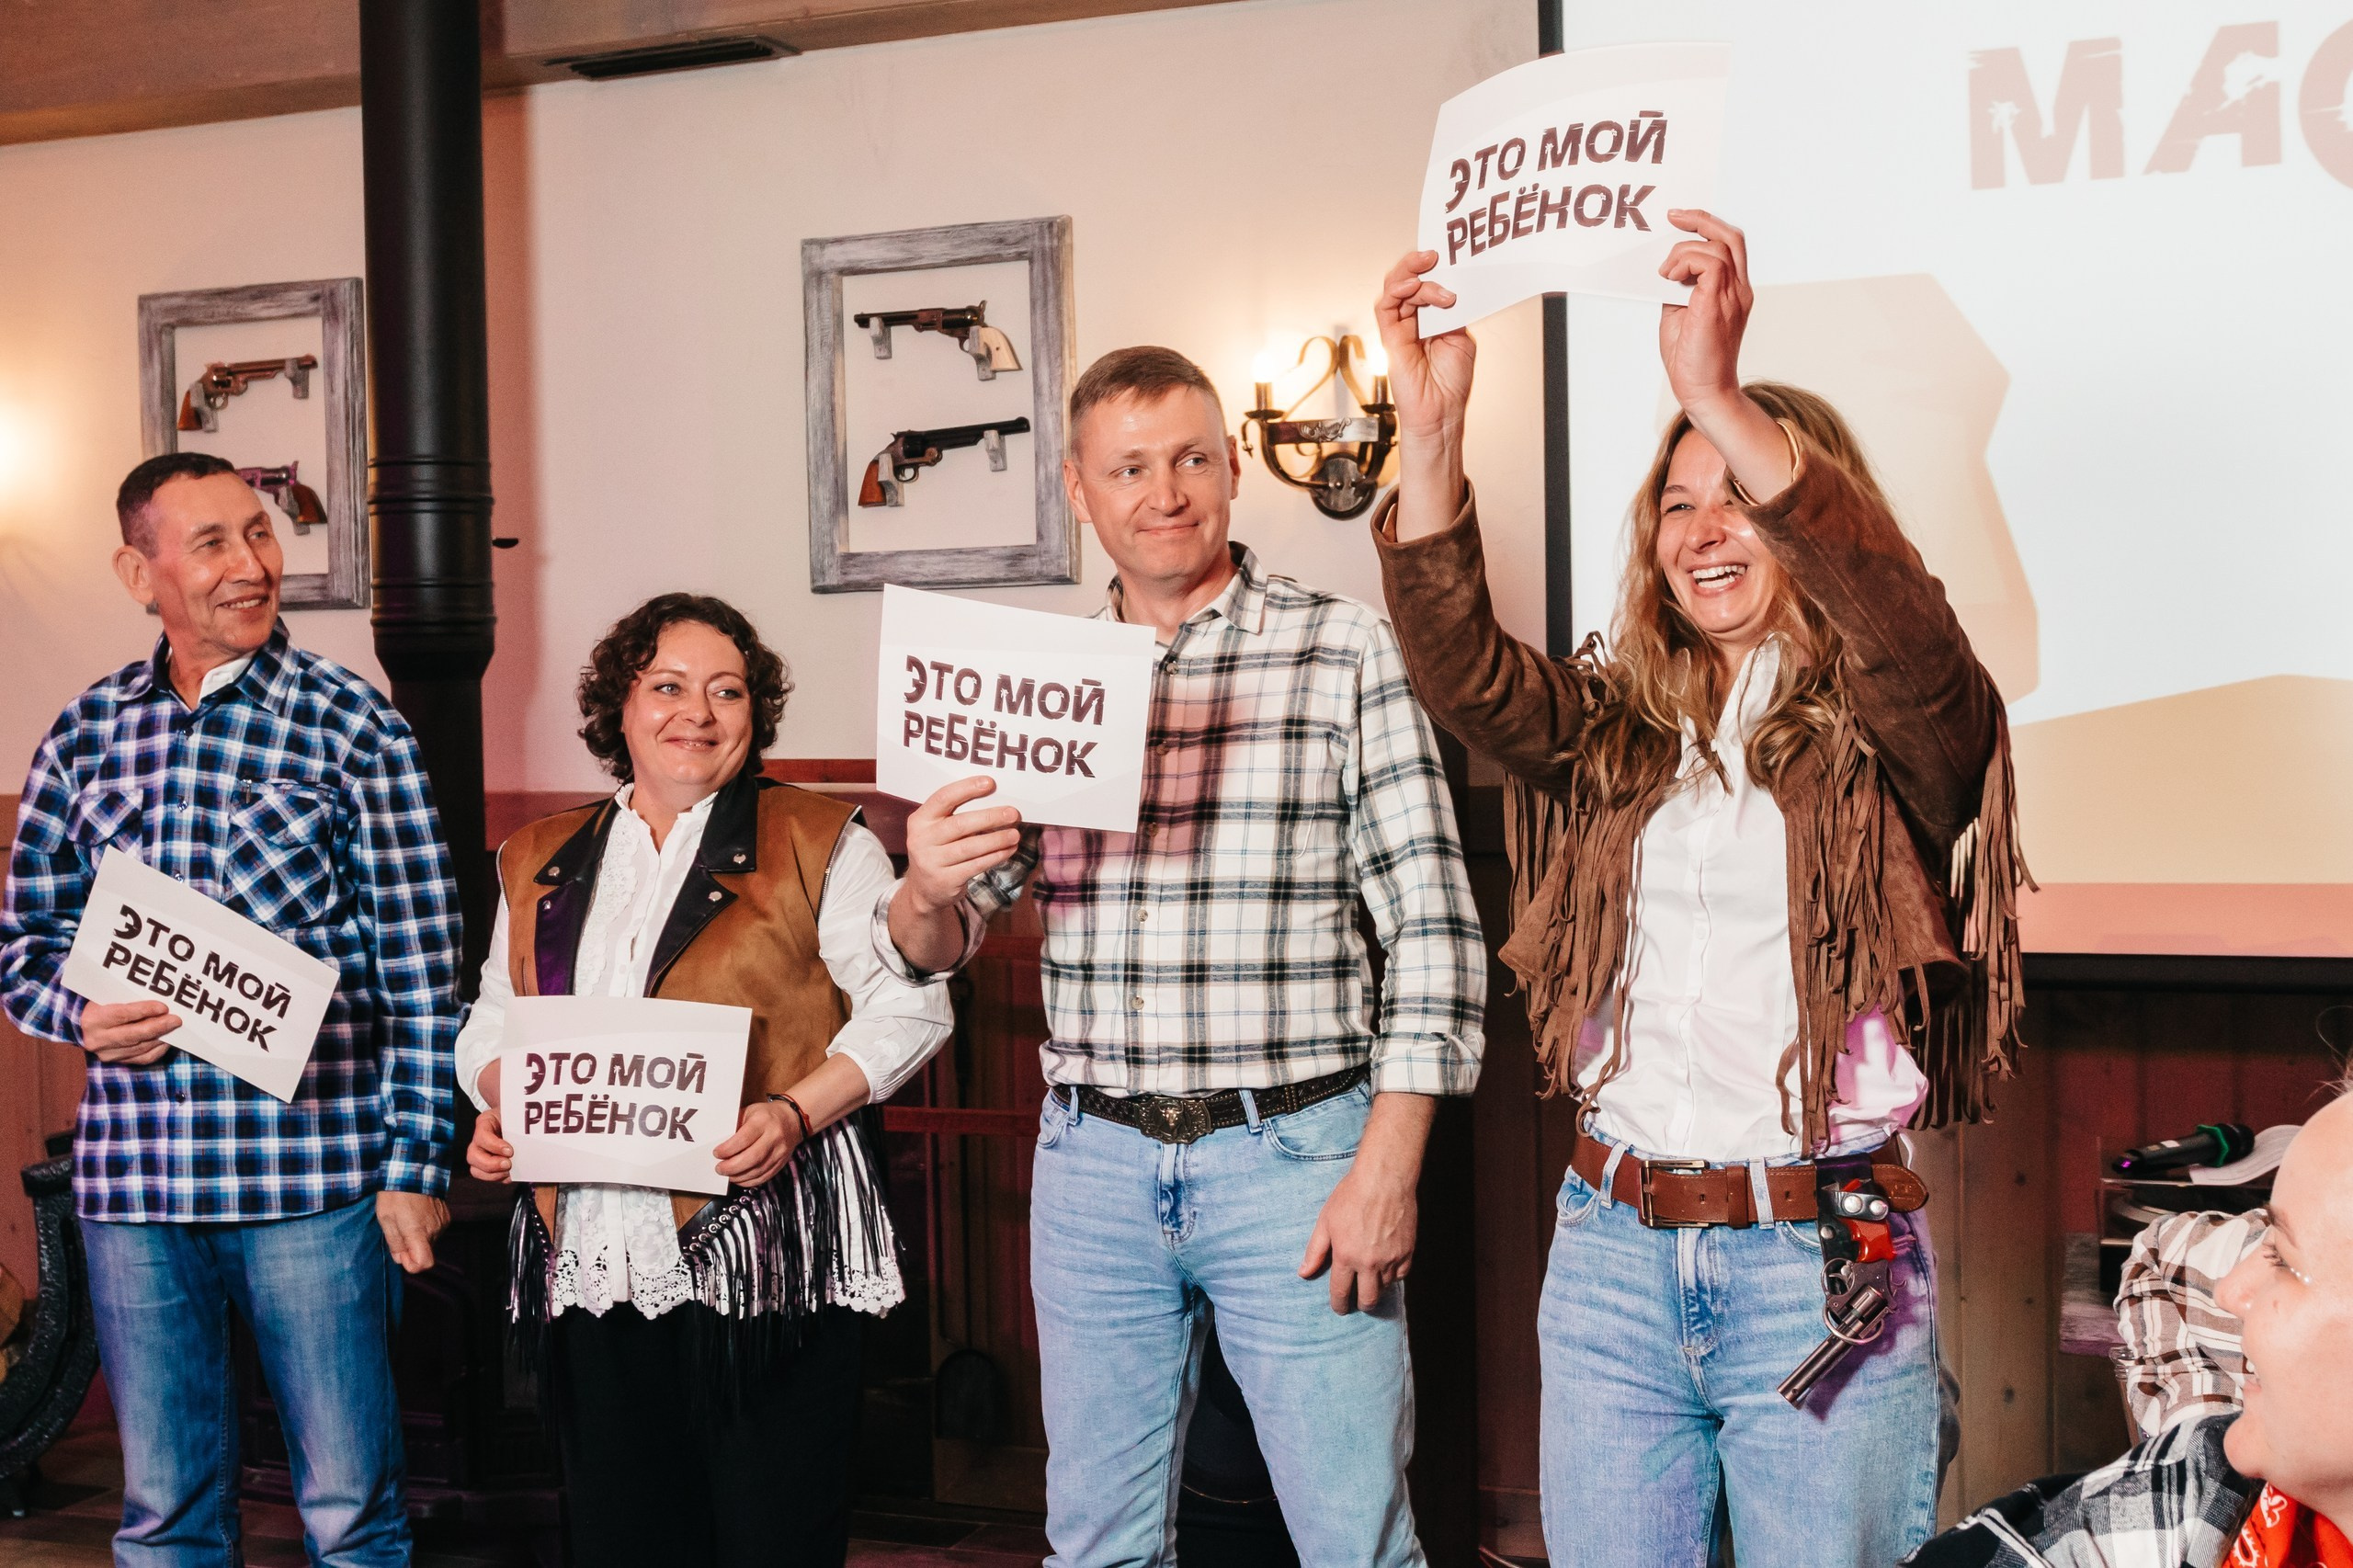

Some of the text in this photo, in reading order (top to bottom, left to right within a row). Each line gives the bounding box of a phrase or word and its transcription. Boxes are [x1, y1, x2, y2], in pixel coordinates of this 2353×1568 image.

[1445, 109, 1668, 213] ЭТО МОЙ
[1446, 183, 1656, 266] РЕБЁНОК
[904, 654, 1106, 725] ЭТО МОЙ
[904, 710, 1098, 778] РЕБЁНОК
[102, 941, 278, 1052] РЕБЁНОК
[113, 904, 292, 1019] ЭТО МОЙ
[524, 1052, 707, 1095] ЭТО МОЙ
[524, 1094, 699, 1142] РЕБЁНОК
